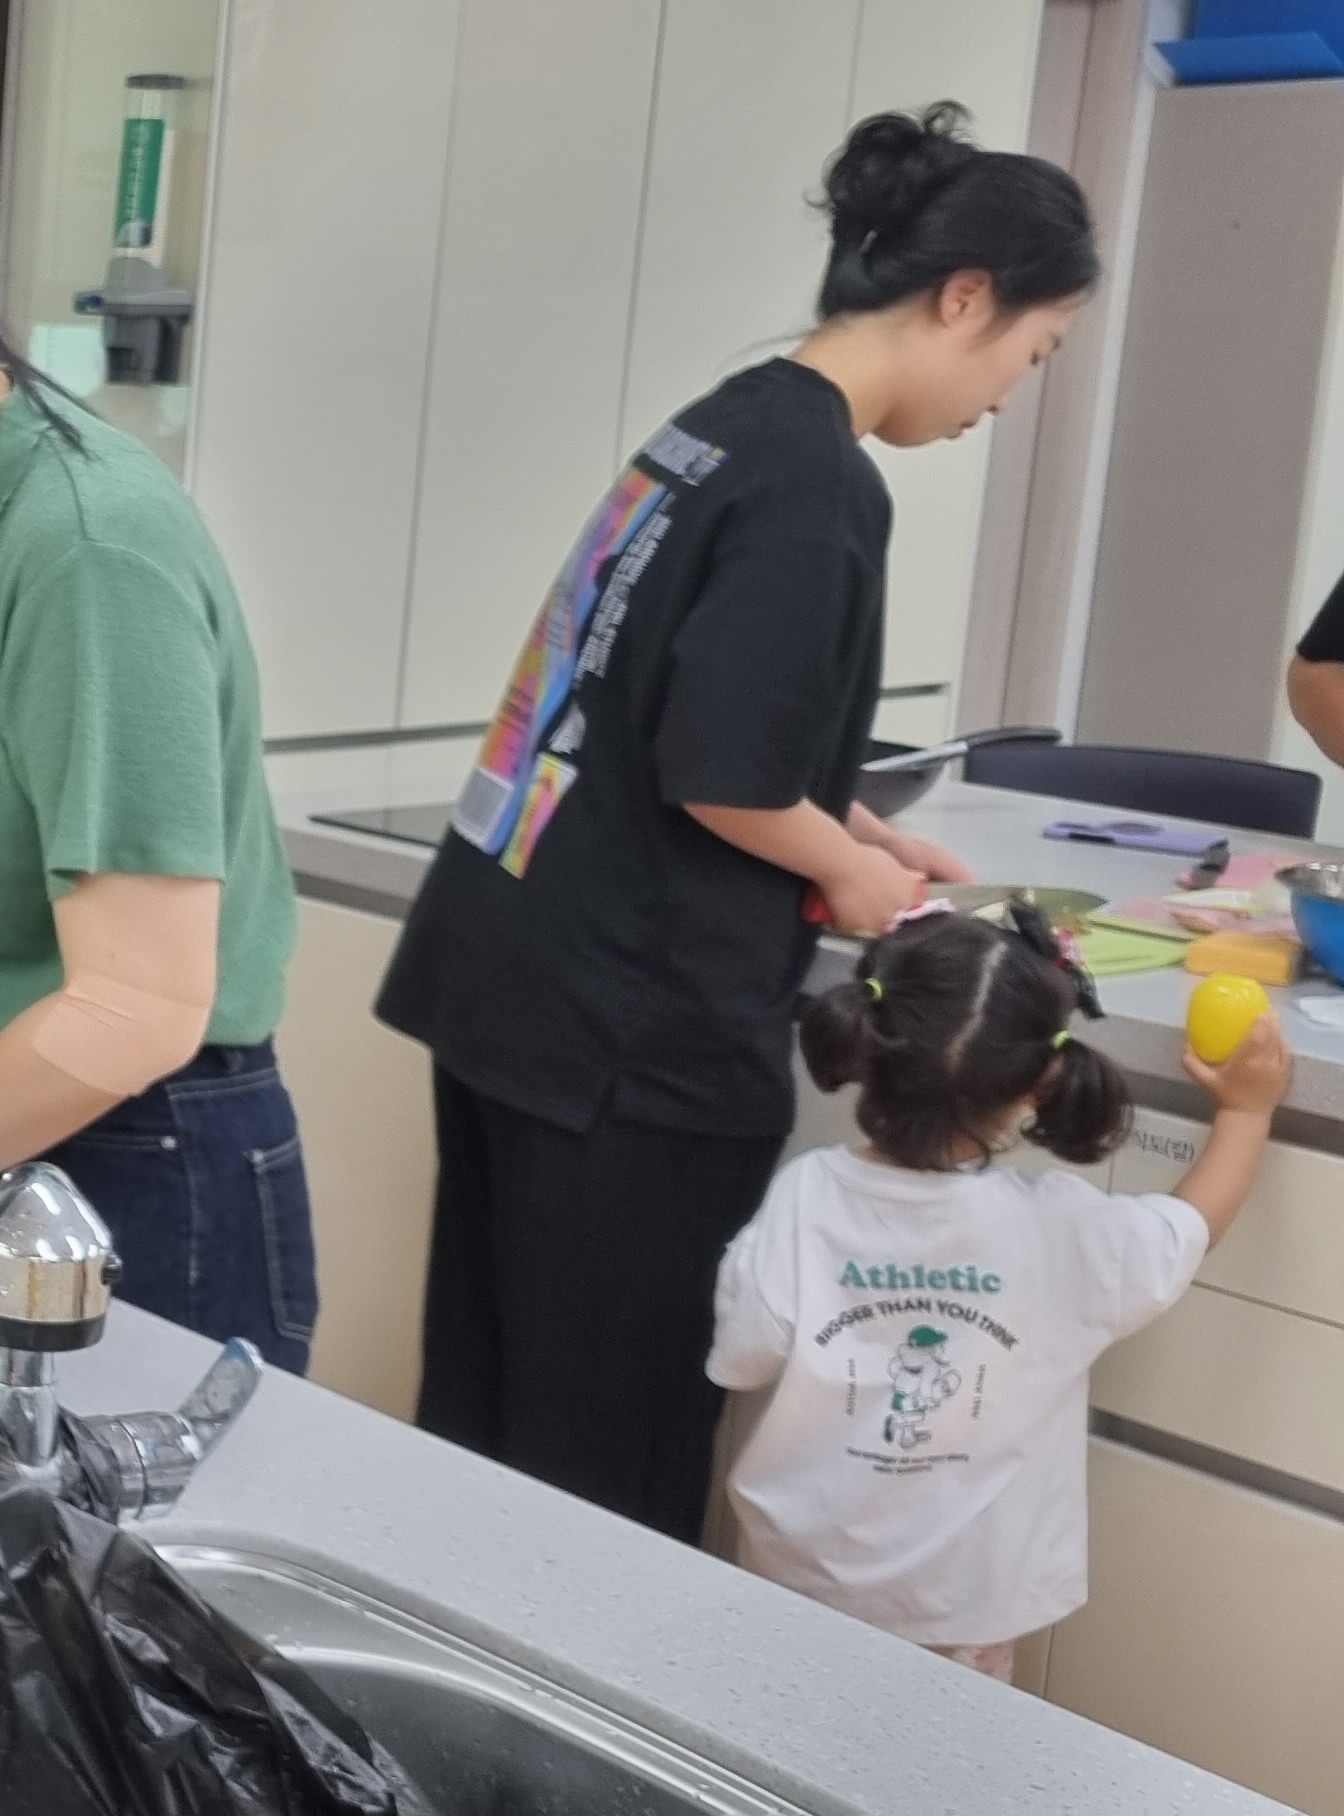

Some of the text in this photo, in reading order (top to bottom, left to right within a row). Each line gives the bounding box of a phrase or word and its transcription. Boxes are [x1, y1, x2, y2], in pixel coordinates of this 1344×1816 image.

[838, 1259, 1002, 1294] Athletic
[814, 1303, 875, 1348] BIGGER
[876, 1297, 932, 1316] THAN
[936, 1299, 979, 1325] YOU
